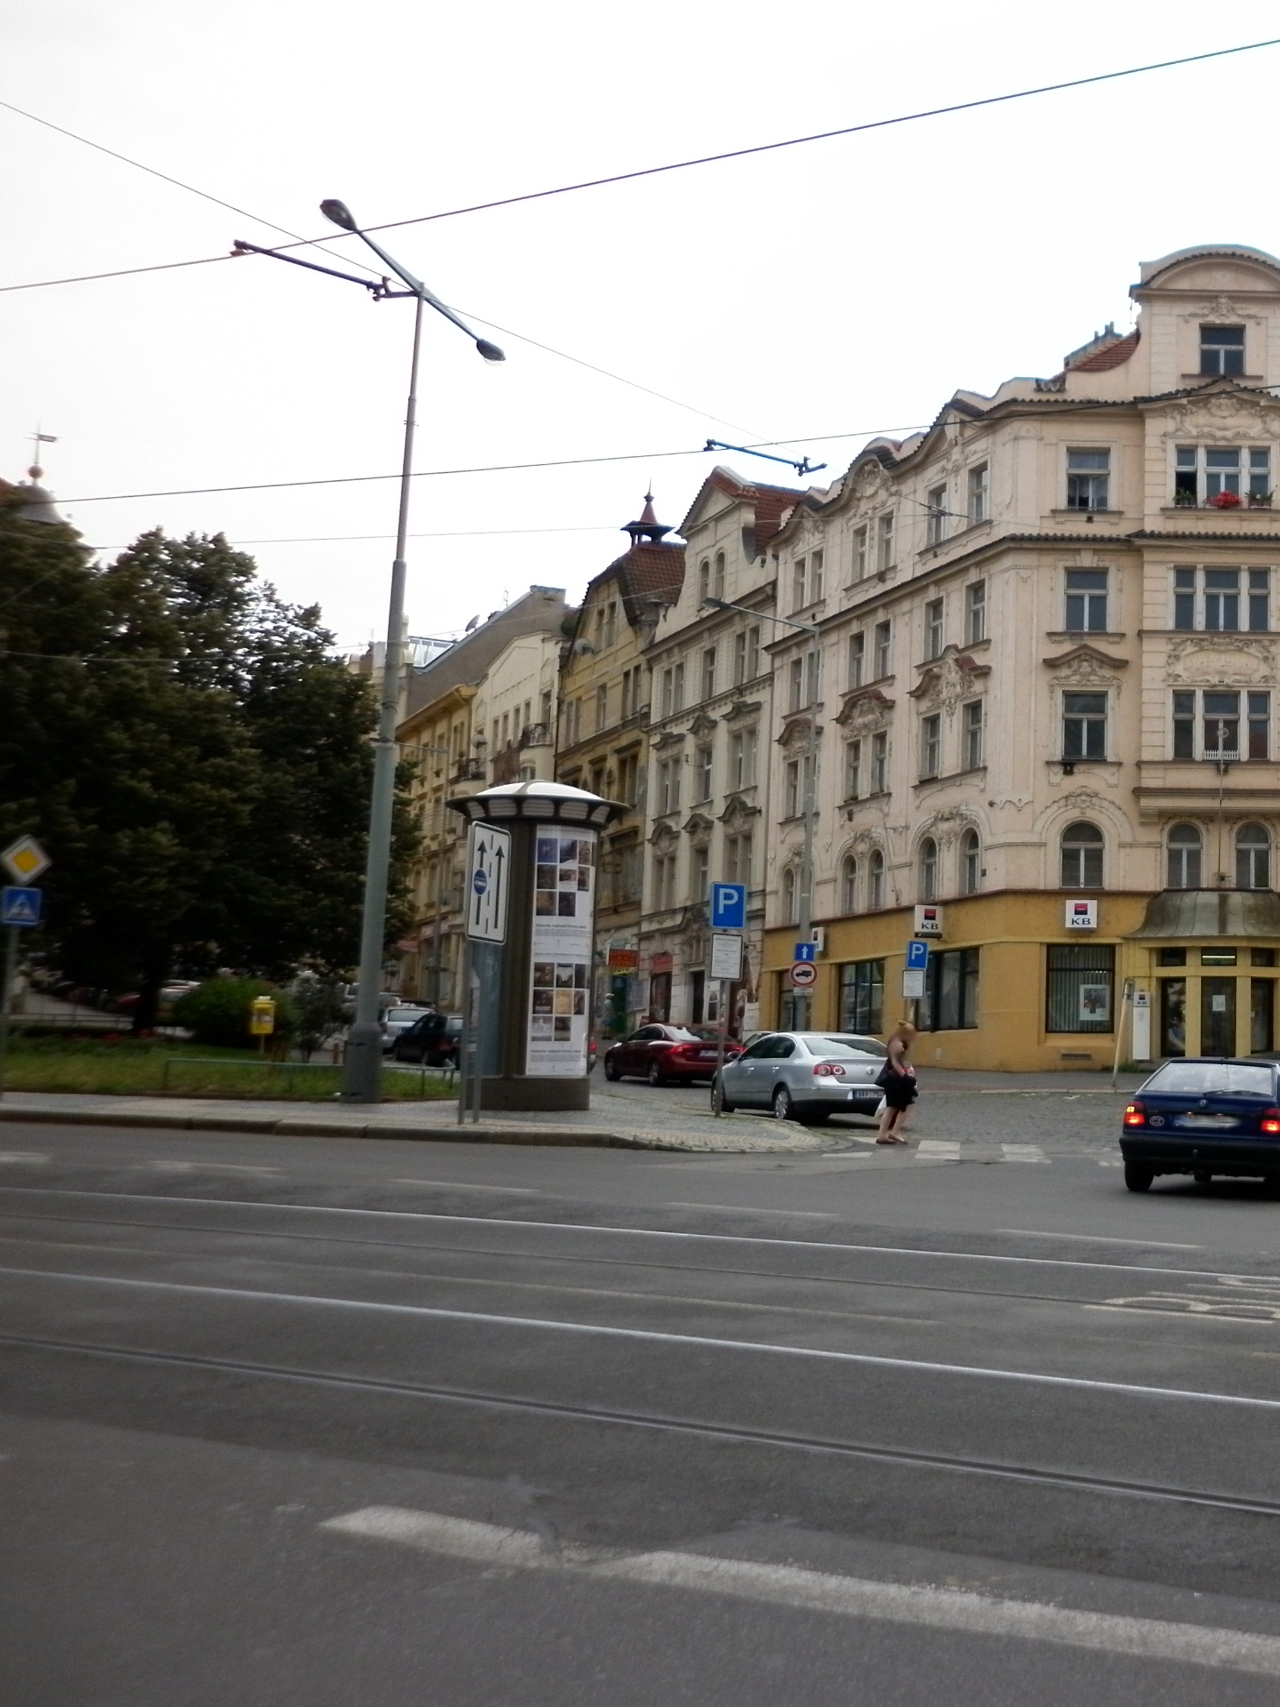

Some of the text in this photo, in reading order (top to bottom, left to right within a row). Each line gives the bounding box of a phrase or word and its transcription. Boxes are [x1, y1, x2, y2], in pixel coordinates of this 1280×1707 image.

[718, 887, 739, 914] P
[921, 922, 939, 930] KB
[1071, 917, 1091, 925] KB
[911, 943, 924, 960] P
